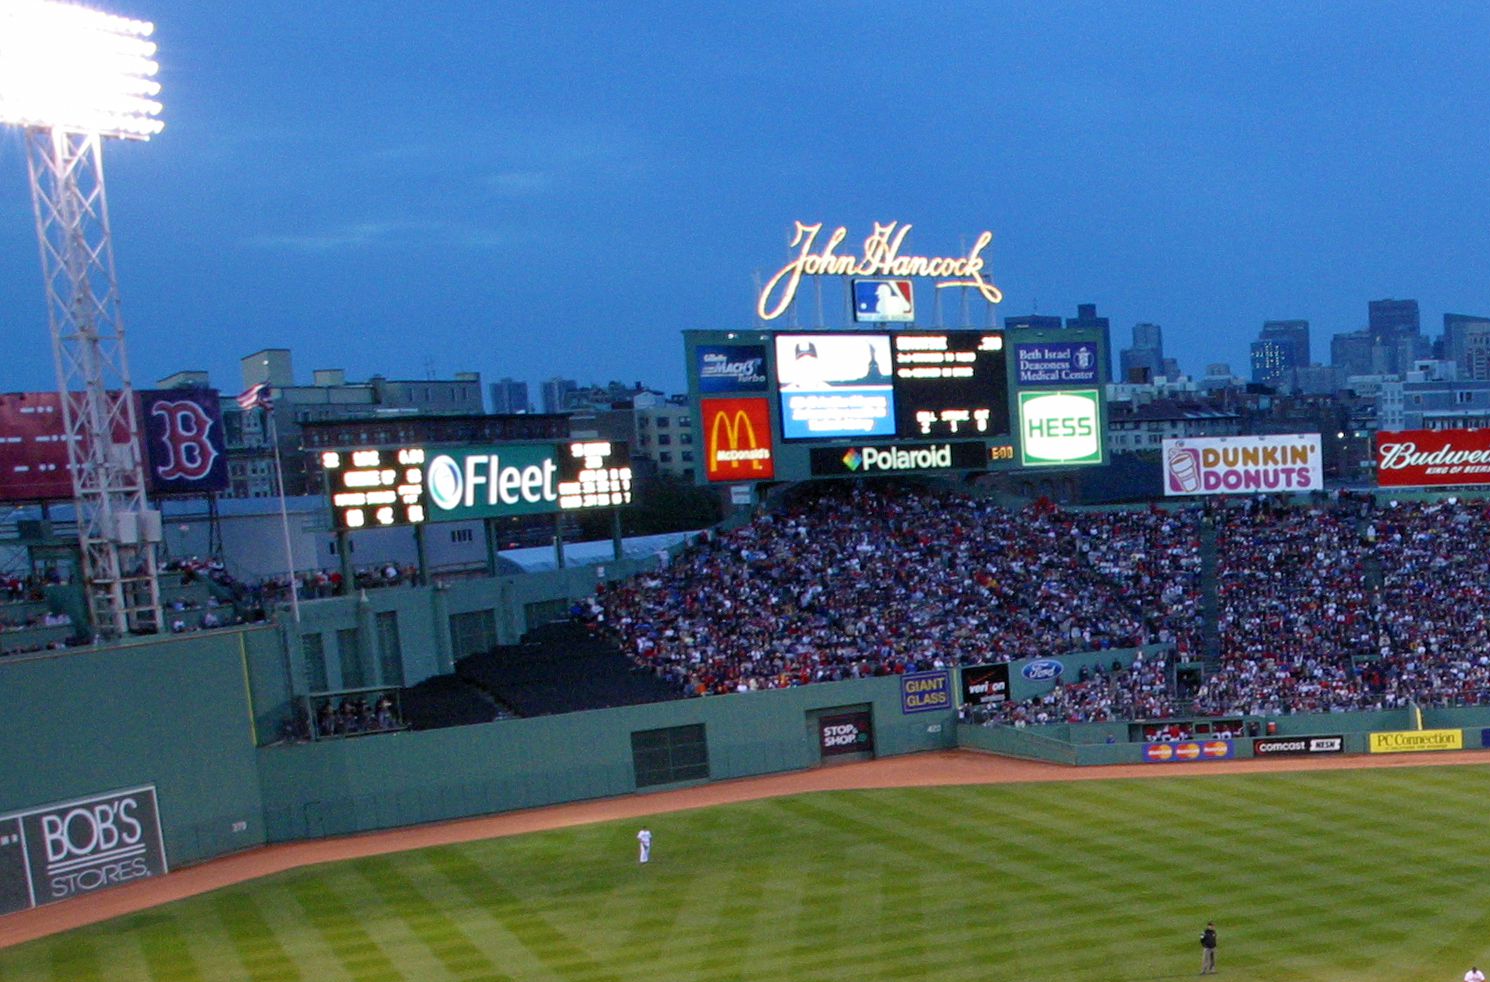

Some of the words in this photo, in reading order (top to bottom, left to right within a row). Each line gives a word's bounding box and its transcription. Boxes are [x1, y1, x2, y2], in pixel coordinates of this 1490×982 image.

[758, 221, 856, 320] John
[856, 221, 1003, 303] Hancock
[1020, 349, 1042, 359] Beth
[1045, 348, 1071, 359] Israel
[1020, 361, 1071, 370] Deaconess
[738, 374, 766, 382] Turbo
[1021, 370, 1059, 381] Medical
[1061, 370, 1094, 380] Center
[1029, 417, 1092, 438] HESS
[717, 448, 770, 461] McDonald's
[862, 444, 951, 471] Polaroid
[1202, 444, 1316, 468] DUNKIN'
[1204, 467, 1311, 490] DONUTS
[1425, 467, 1448, 475] KING
[1450, 466, 1461, 474] OF
[464, 454, 558, 507] Fleet
[1029, 662, 1055, 678] Ford
[906, 677, 945, 693] GIANT
[907, 690, 946, 706] GLASS
[824, 723, 853, 736] STOP
[825, 734, 856, 747] SHOP
[1259, 741, 1306, 751] comcast
[1377, 734, 1393, 746] PC
[1395, 732, 1455, 745] Connection
[42, 798, 141, 862] BOB'S
[51, 857, 147, 898] STORES
